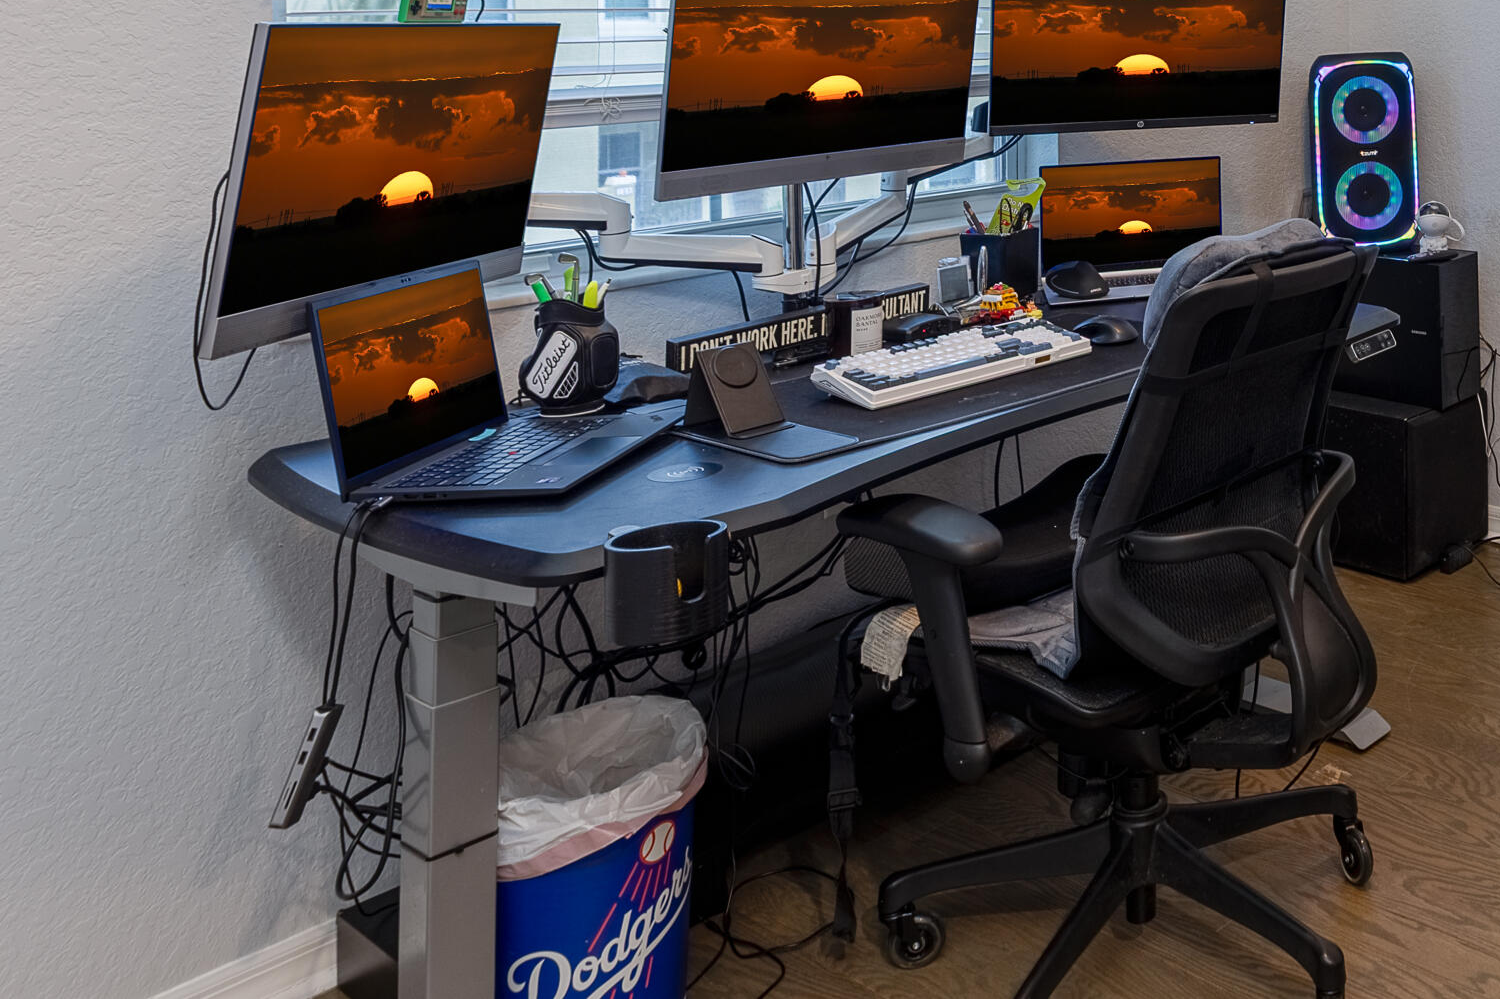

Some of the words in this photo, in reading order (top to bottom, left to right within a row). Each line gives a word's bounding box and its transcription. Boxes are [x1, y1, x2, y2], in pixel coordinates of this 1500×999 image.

[532, 337, 570, 393] Titleist
[680, 345, 686, 371] I
[781, 316, 818, 347] HERE.
[881, 289, 926, 320] SULTANT
[507, 845, 692, 999] Dodgers
